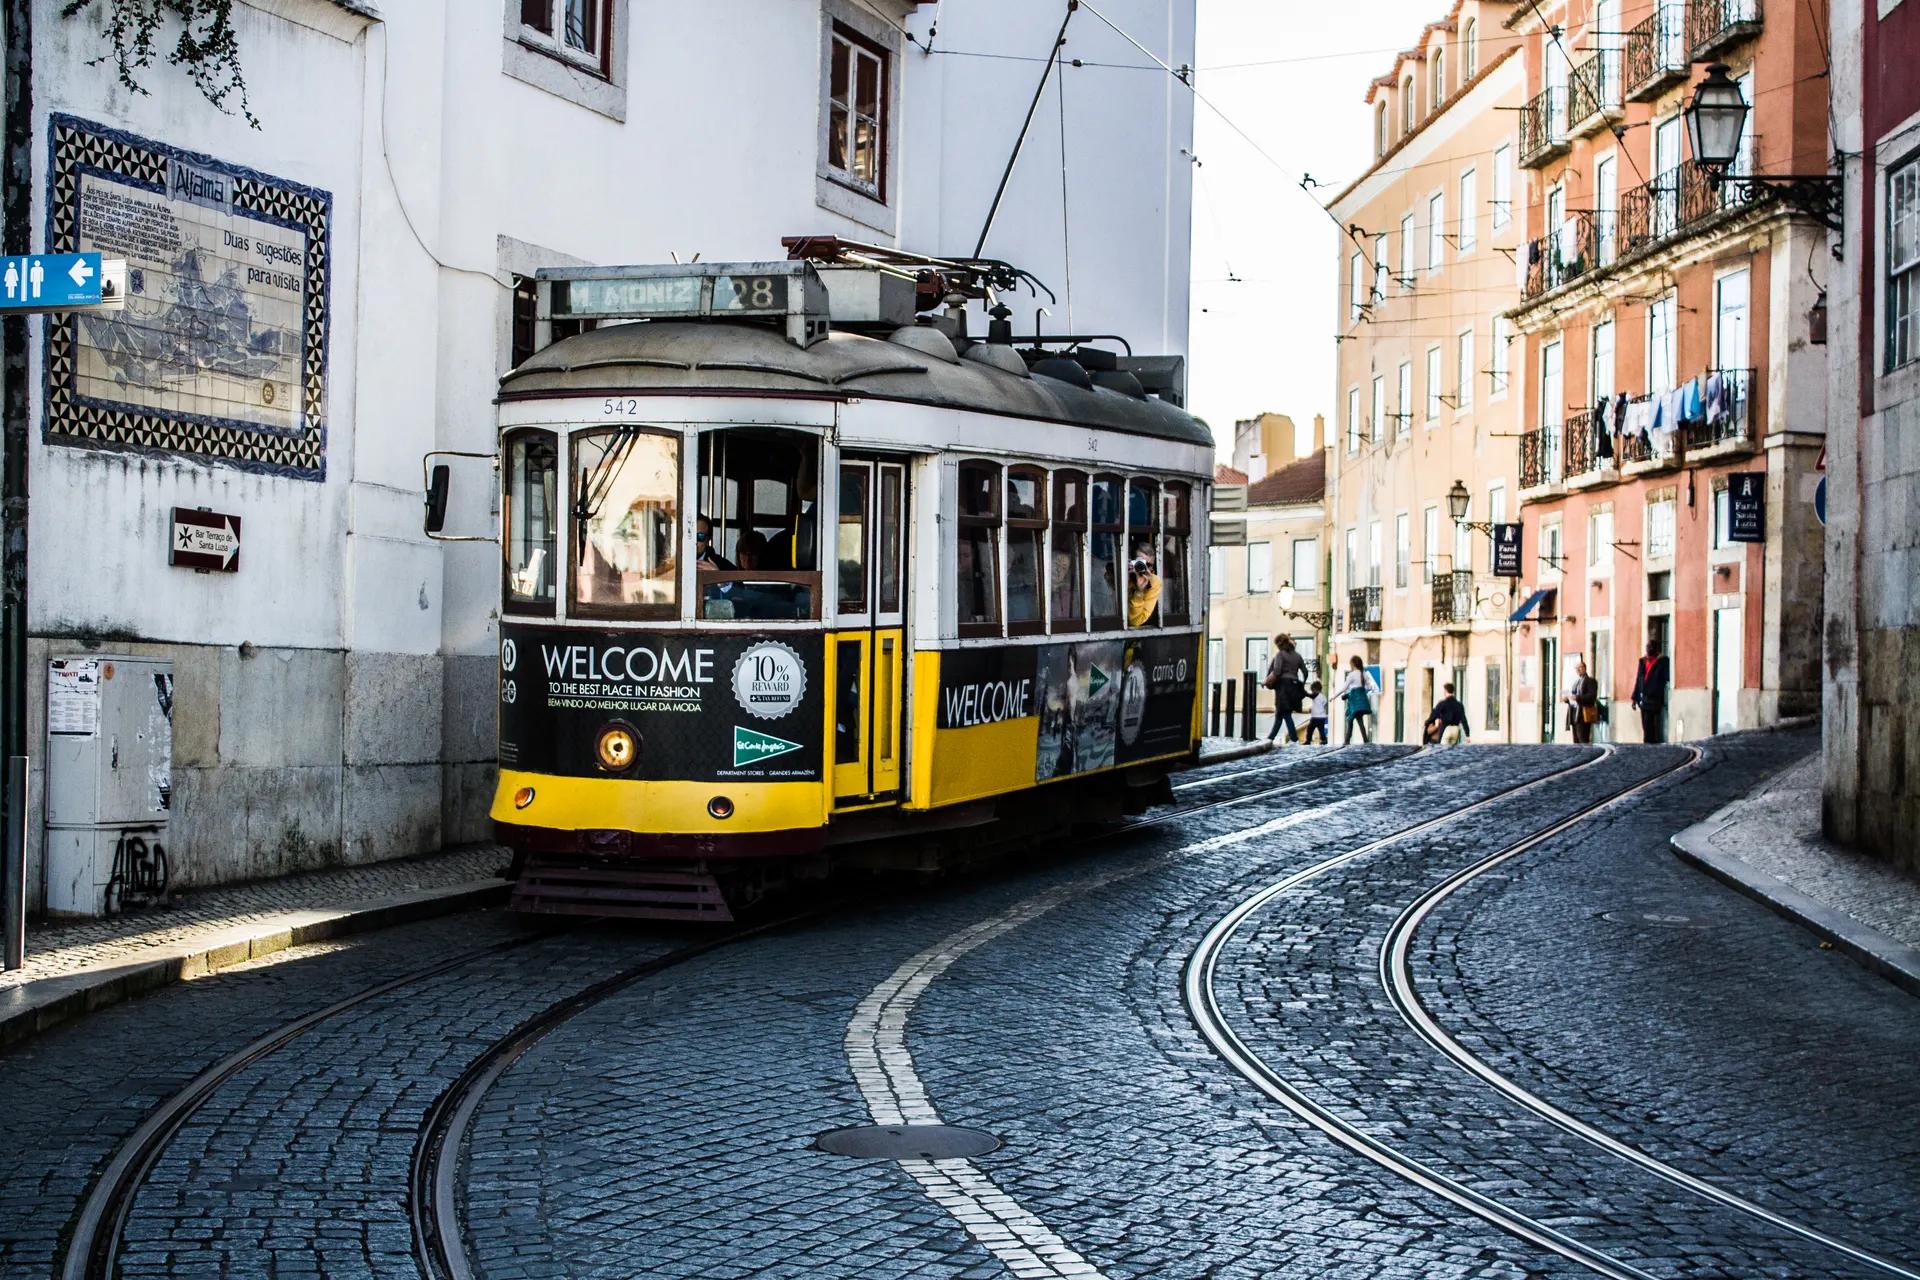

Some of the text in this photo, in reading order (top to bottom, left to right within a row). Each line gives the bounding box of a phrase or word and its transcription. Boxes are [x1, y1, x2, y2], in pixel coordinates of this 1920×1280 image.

[175, 164, 224, 203] Alfama
[223, 230, 302, 266] Duas sugestões
[247, 267, 301, 293] para visita
[603, 398, 638, 416] 542
[1087, 436, 1098, 452] 542
[195, 529, 233, 543] Bar Terraço de
[198, 540, 229, 552] Santa Luzia
[541, 644, 714, 683] WELCOME
[1152, 658, 1174, 682] carris
[548, 682, 701, 698] TO THE BEST PLACE IN FASHION
[752, 681, 790, 692] REWARD
[548, 698, 702, 713] BEM-VINDO AO MELHOR LUGAR DA MODA
[946, 678, 1030, 729] WELCOME
